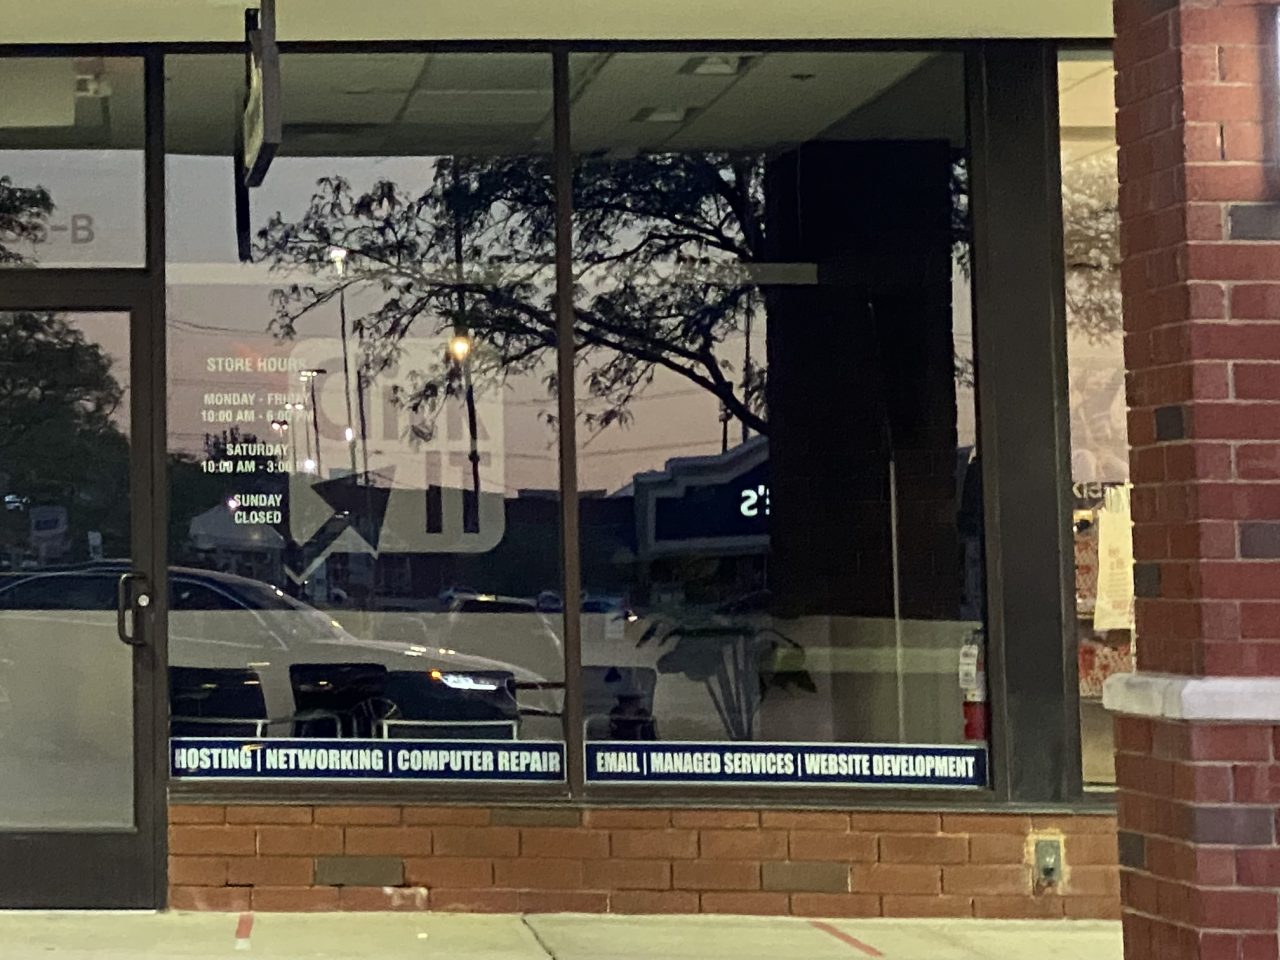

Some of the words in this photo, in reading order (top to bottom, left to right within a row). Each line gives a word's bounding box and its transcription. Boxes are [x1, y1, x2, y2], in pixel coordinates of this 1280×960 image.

[206, 357, 254, 372] STORE
[257, 357, 307, 372] HOURS
[204, 392, 256, 406] MONDAY
[267, 392, 309, 406] FRIDAY
[201, 409, 233, 423] 10:00
[235, 409, 255, 423] AM
[226, 443, 289, 457] SATURDAY
[201, 460, 234, 474] 10:00
[236, 460, 256, 474] AM
[266, 460, 293, 474] 3:00
[424, 450, 493, 534] IT
[233, 493, 283, 507] SUNDAY
[234, 511, 282, 524] CLOSED
[174, 747, 252, 770] HOSTING
[265, 748, 384, 771] NETWORKING
[397, 749, 494, 772] COMPUTER
[498, 750, 561, 773] REPAIR
[596, 751, 640, 773] EMAIL
[650, 752, 721, 774] MANAGED
[723, 753, 795, 775] SERVICES
[804, 753, 871, 776] WEBSITE
[872, 754, 975, 778] DEVELOPMENT
